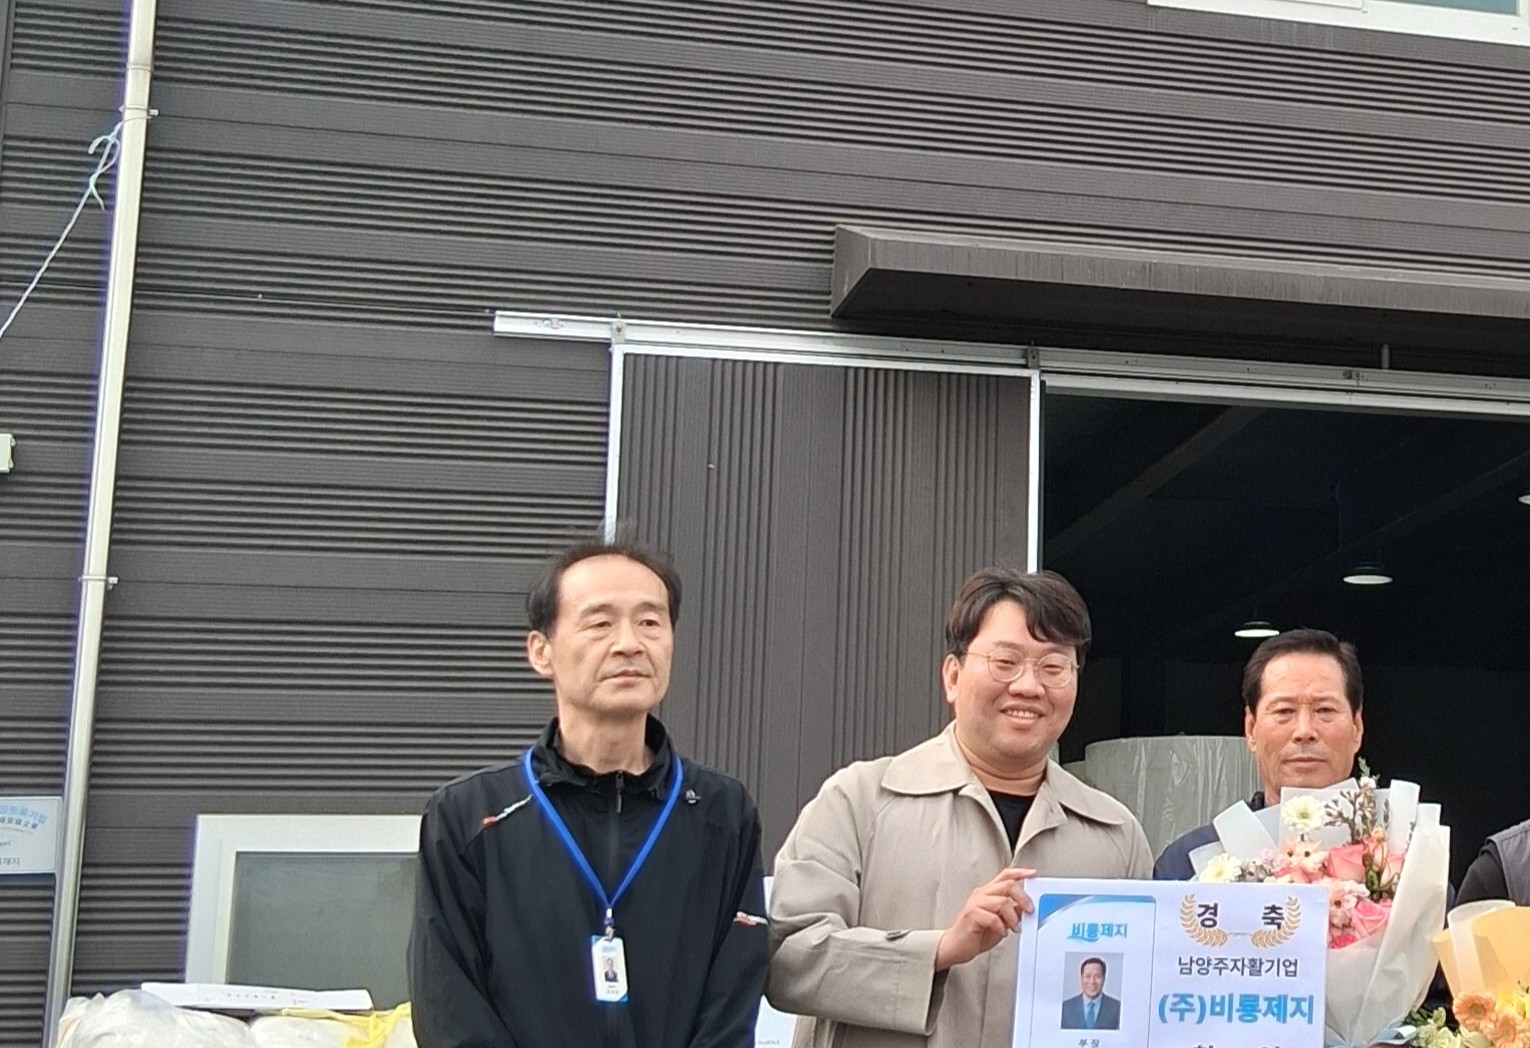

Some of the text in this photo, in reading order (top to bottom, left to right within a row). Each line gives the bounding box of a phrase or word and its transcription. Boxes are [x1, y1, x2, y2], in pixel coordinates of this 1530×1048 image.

[1197, 902, 1285, 930] 경 축
[1071, 921, 1128, 940] 비룡제지
[1178, 955, 1299, 978] 남양주자활기업
[1158, 993, 1315, 1025] (주)비룡제지
